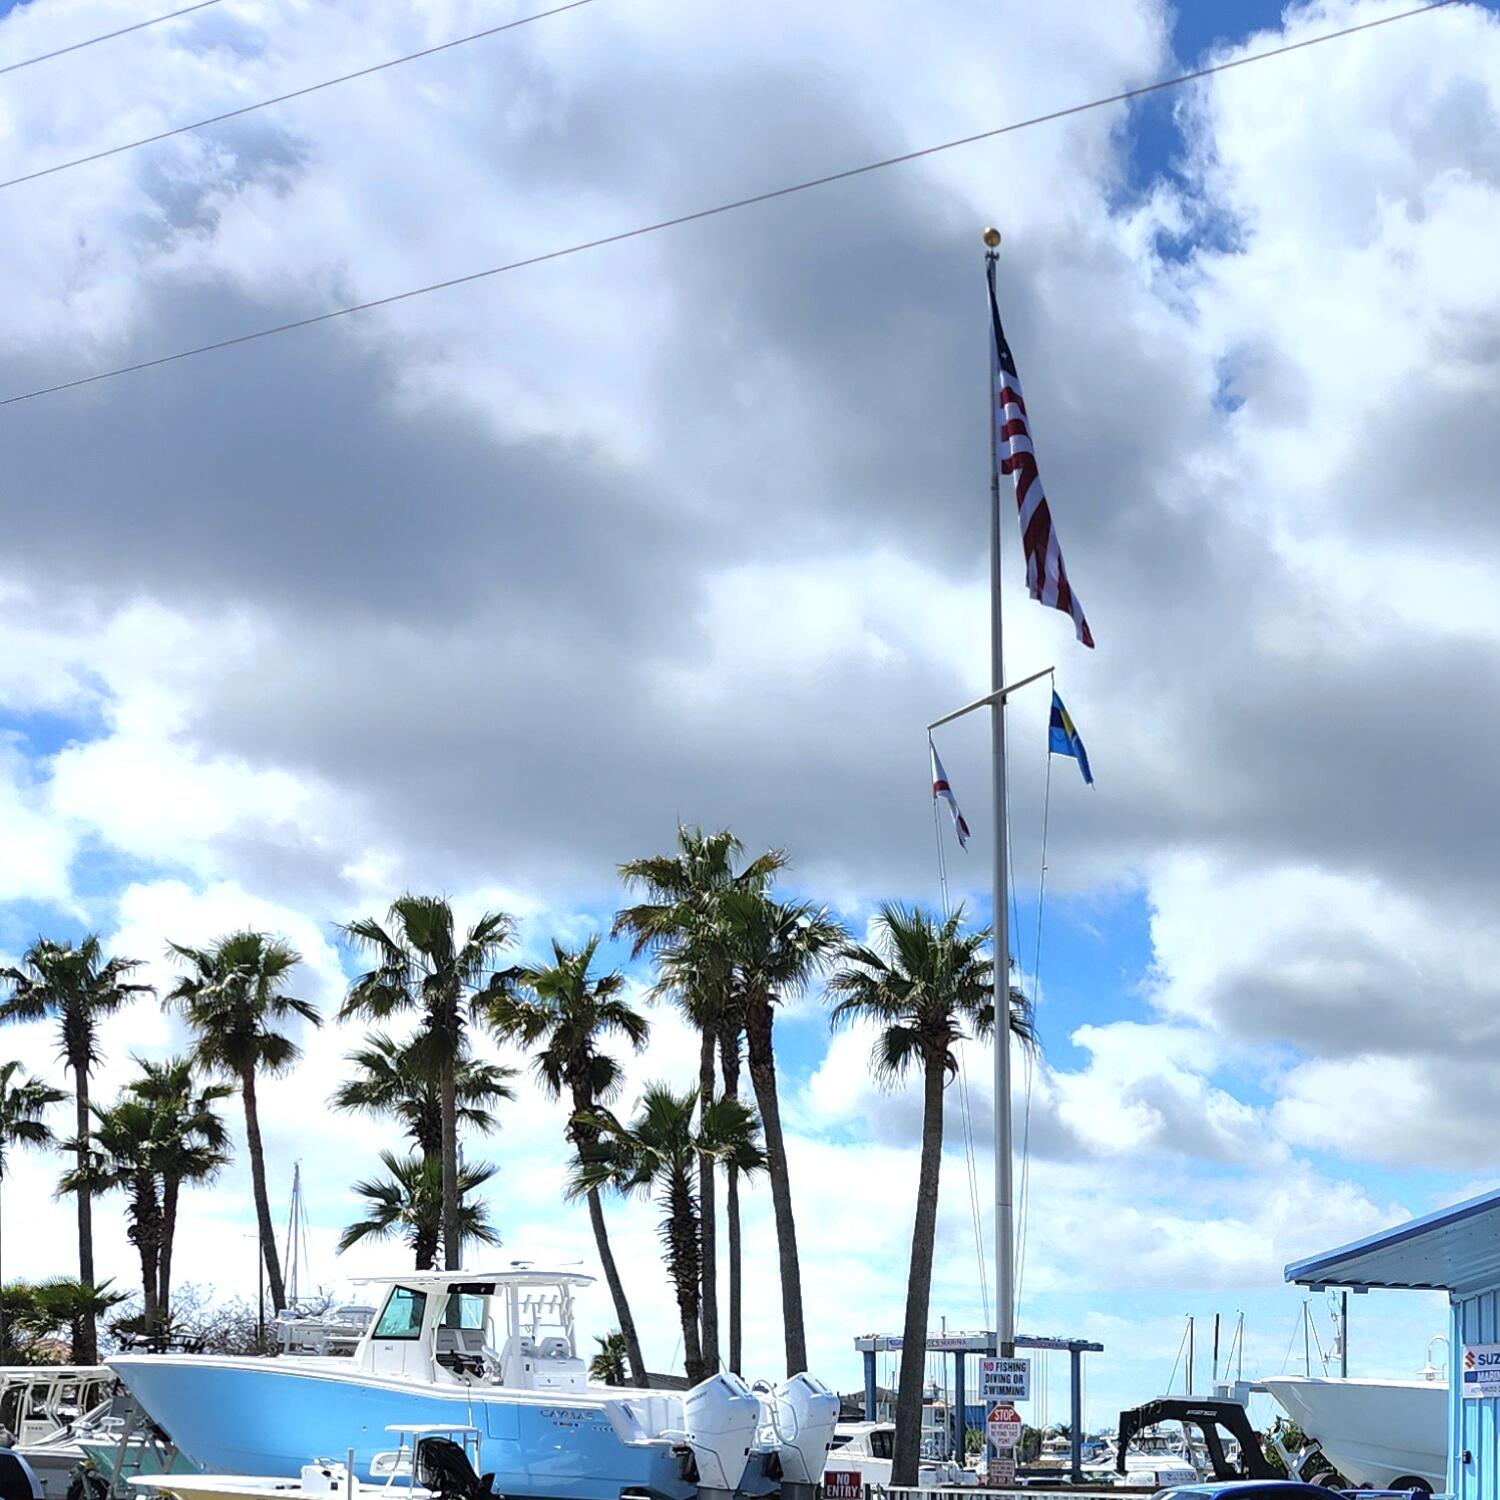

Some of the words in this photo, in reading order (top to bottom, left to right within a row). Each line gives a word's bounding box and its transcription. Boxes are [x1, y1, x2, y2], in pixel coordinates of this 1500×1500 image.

[983, 1362, 994, 1372] NO
[996, 1362, 1026, 1373] FISHING
[985, 1374, 1011, 1384] DIVING
[1013, 1374, 1024, 1382] OR
[983, 1385, 1026, 1396] SWIMMING
[994, 1409, 1014, 1421] STOP
[836, 1473, 850, 1485] NO
[826, 1485, 858, 1498] ENTRY
